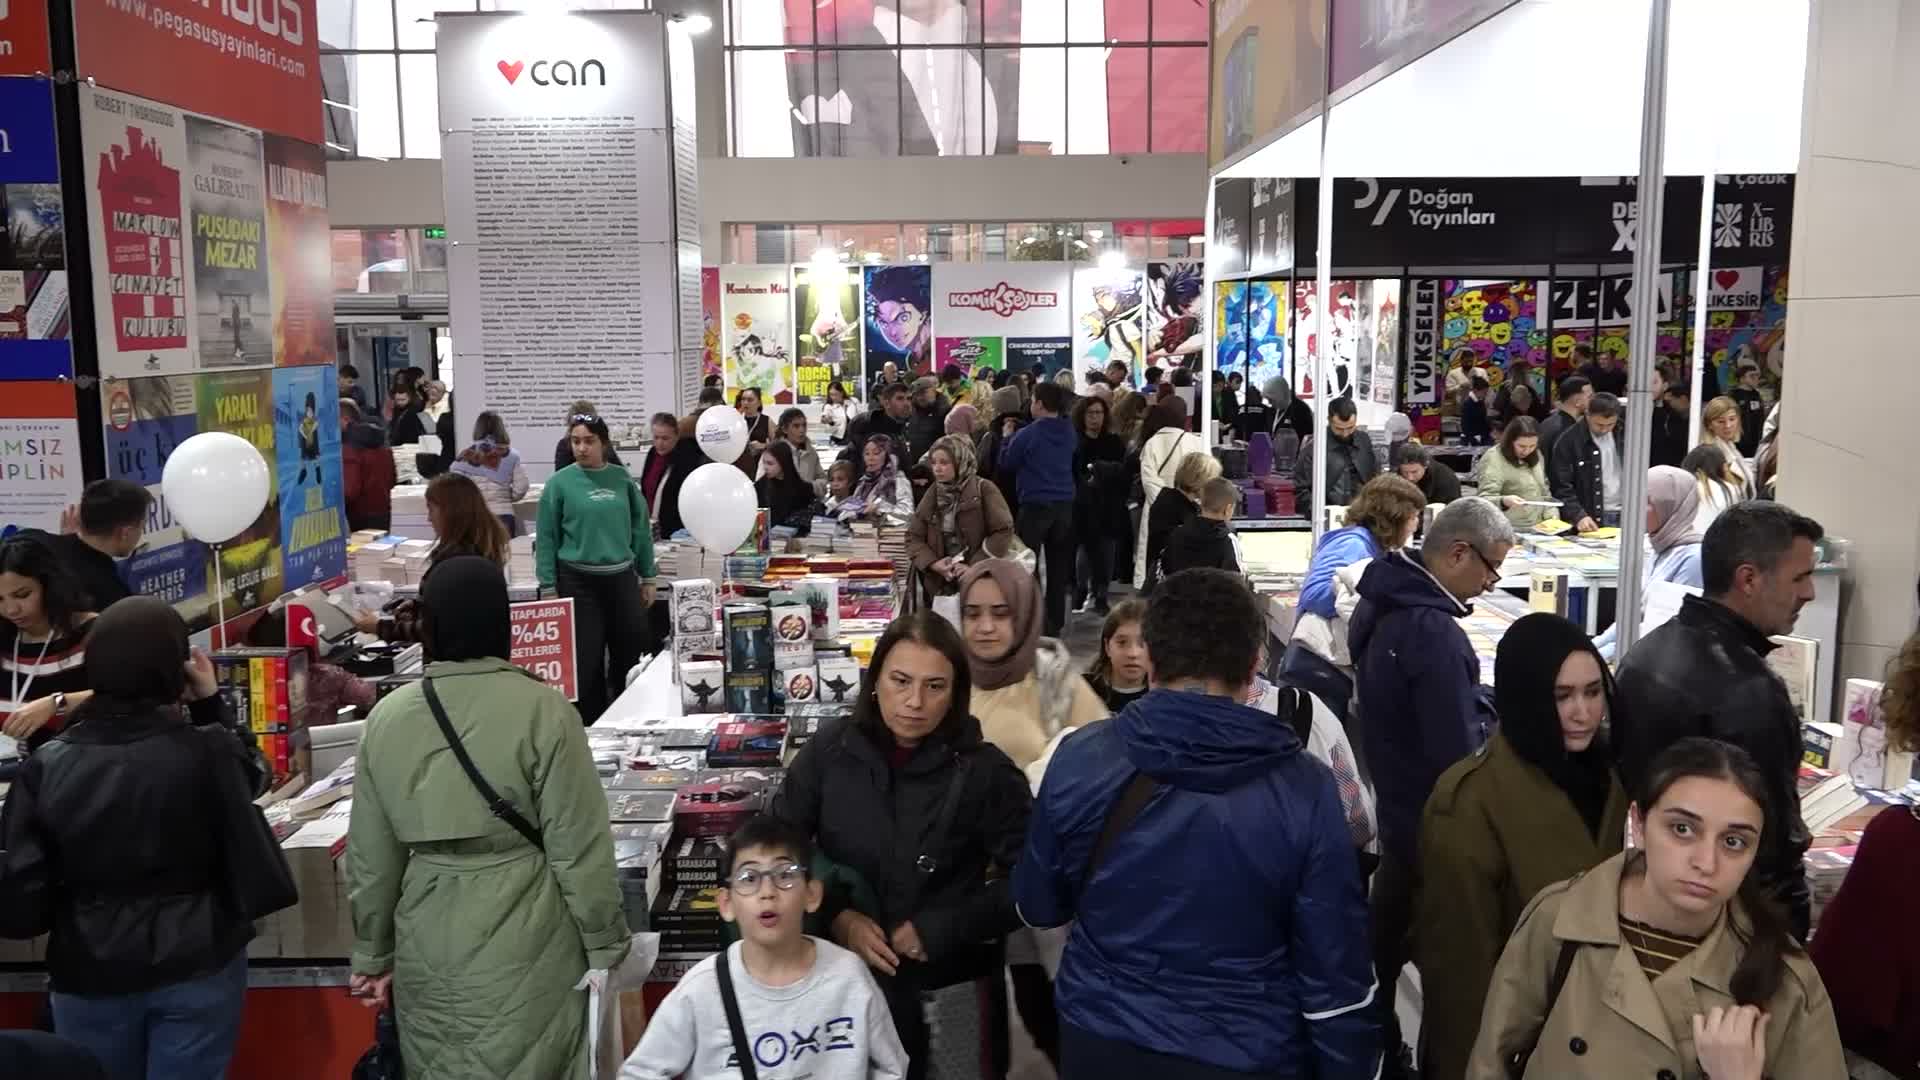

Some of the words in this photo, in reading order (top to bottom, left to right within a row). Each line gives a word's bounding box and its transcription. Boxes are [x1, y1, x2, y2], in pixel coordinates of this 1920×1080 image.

[531, 59, 606, 86] can
[1408, 188, 1474, 209] Doğan
[114, 211, 179, 238] MARLOW
[1408, 207, 1496, 230] Yayınları
[206, 240, 257, 270] MEZAR
[1686, 291, 1758, 309] BLIKESİR
[215, 392, 258, 424] YARALI
[0, 439, 63, 456] MSIZ
[117, 440, 148, 480] üç
[140, 568, 186, 593] HEATHER
[153, 583, 184, 600] ORRIS
[510, 606, 566, 621] ITAPLARDA
[511, 620, 560, 645] %45
[511, 644, 562, 660] SETLERDE
[516, 661, 562, 682] 50
[677, 859, 717, 869] KARABASAN
[677, 871, 717, 881] KARABASAN
